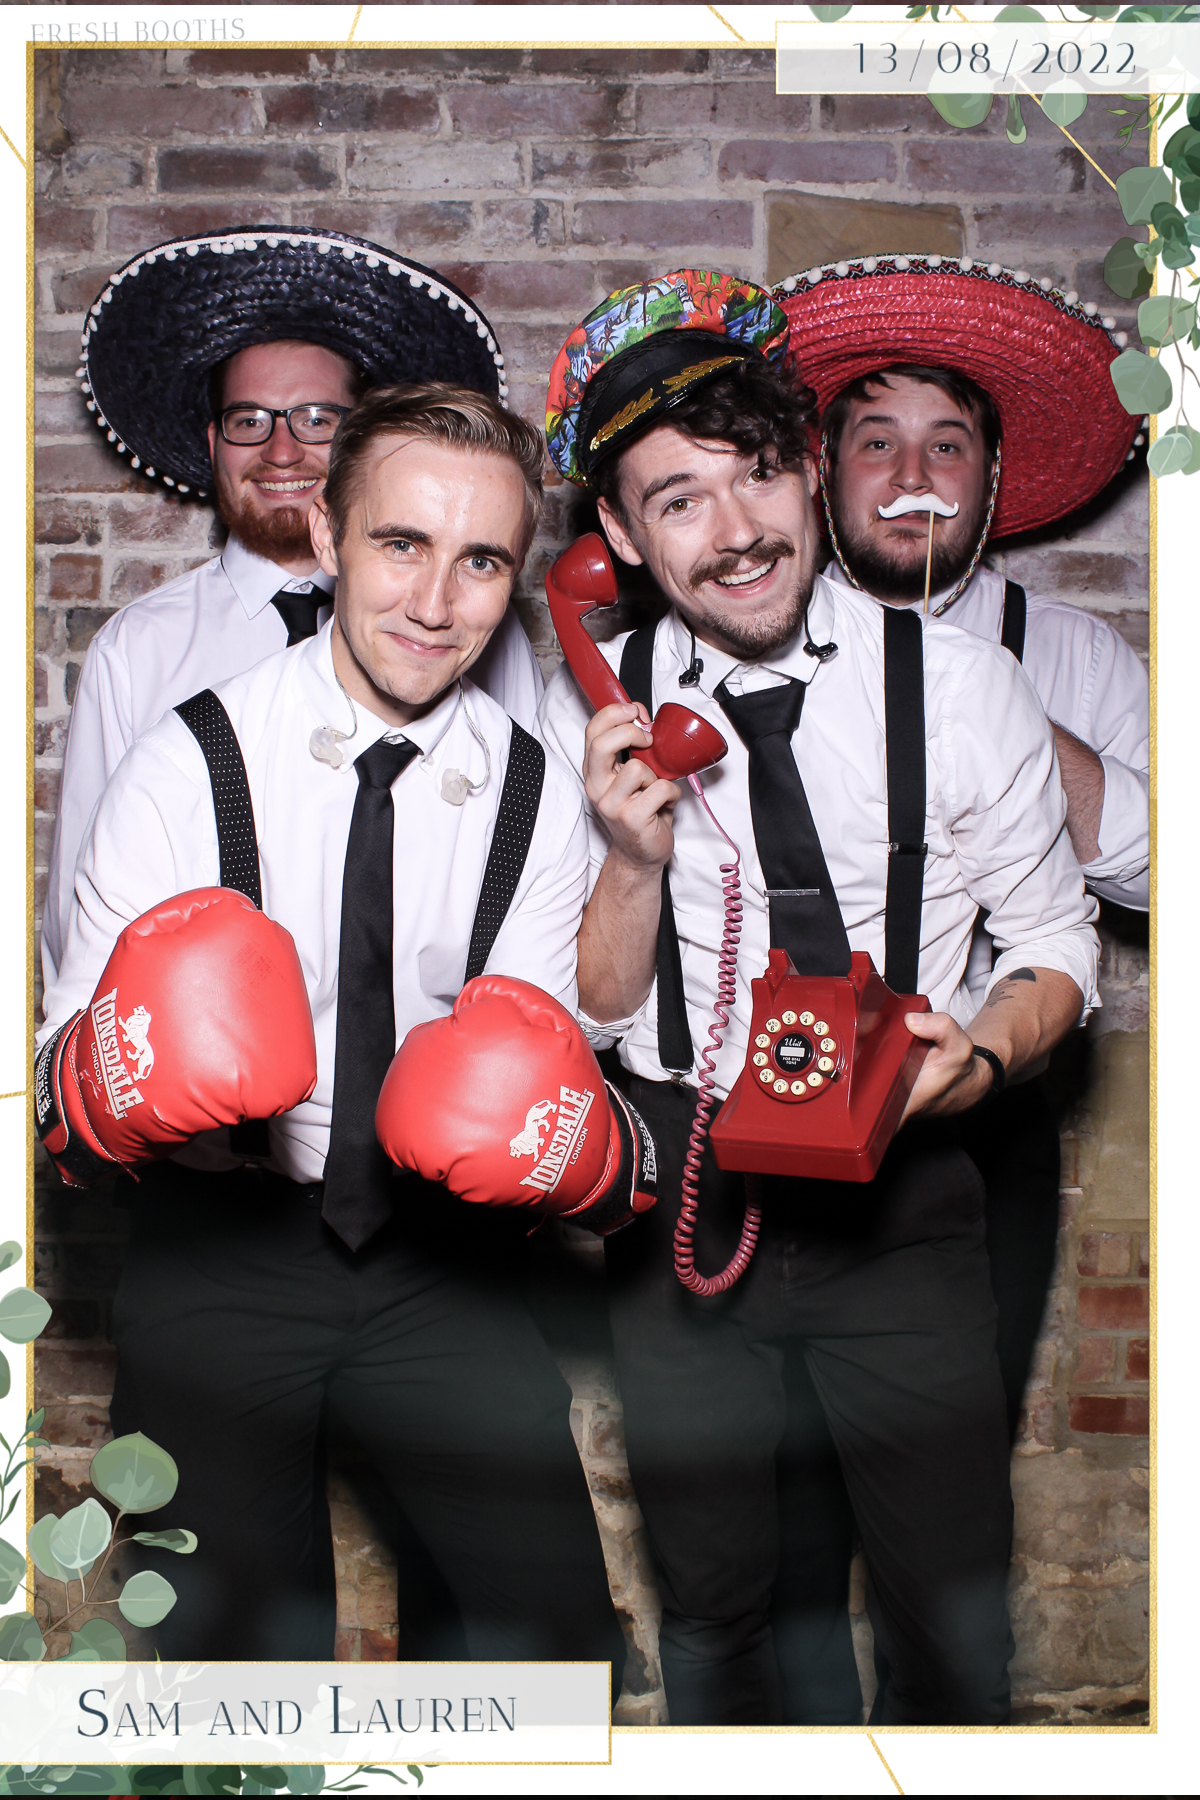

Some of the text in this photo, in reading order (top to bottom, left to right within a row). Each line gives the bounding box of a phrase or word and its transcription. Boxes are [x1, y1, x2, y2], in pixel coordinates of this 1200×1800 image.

[91, 987, 145, 1120] LONSDALE
[91, 1041, 103, 1085] LONDON
[519, 1085, 595, 1193] LONSDALE
[569, 1127, 588, 1166] LONDON
